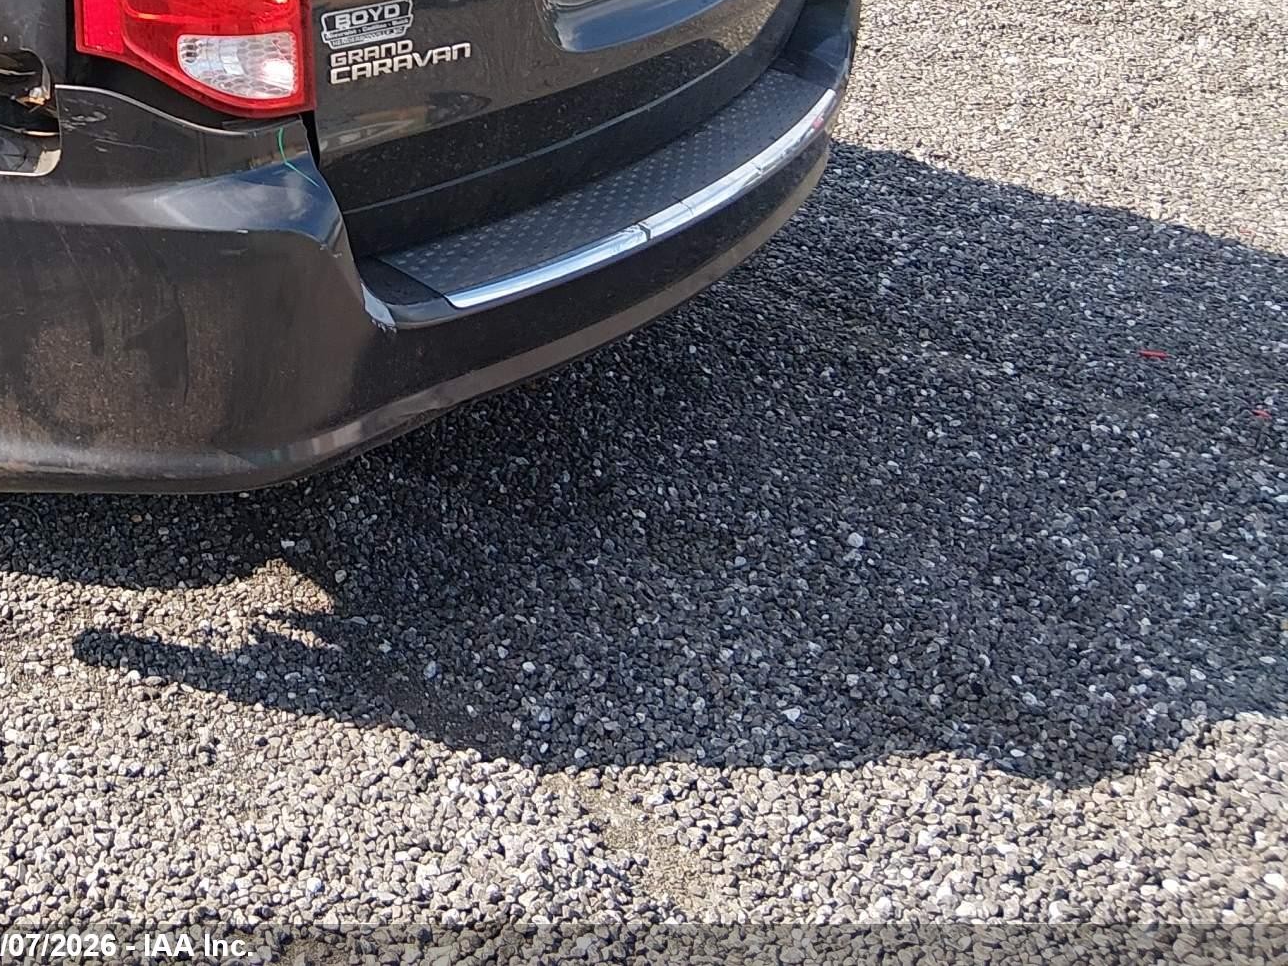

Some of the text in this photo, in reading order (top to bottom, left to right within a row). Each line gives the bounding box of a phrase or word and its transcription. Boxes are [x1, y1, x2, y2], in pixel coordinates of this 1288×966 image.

[335, 3, 401, 29] BOYD
[330, 39, 414, 68] GRAND
[330, 42, 472, 84] CARAVAN
